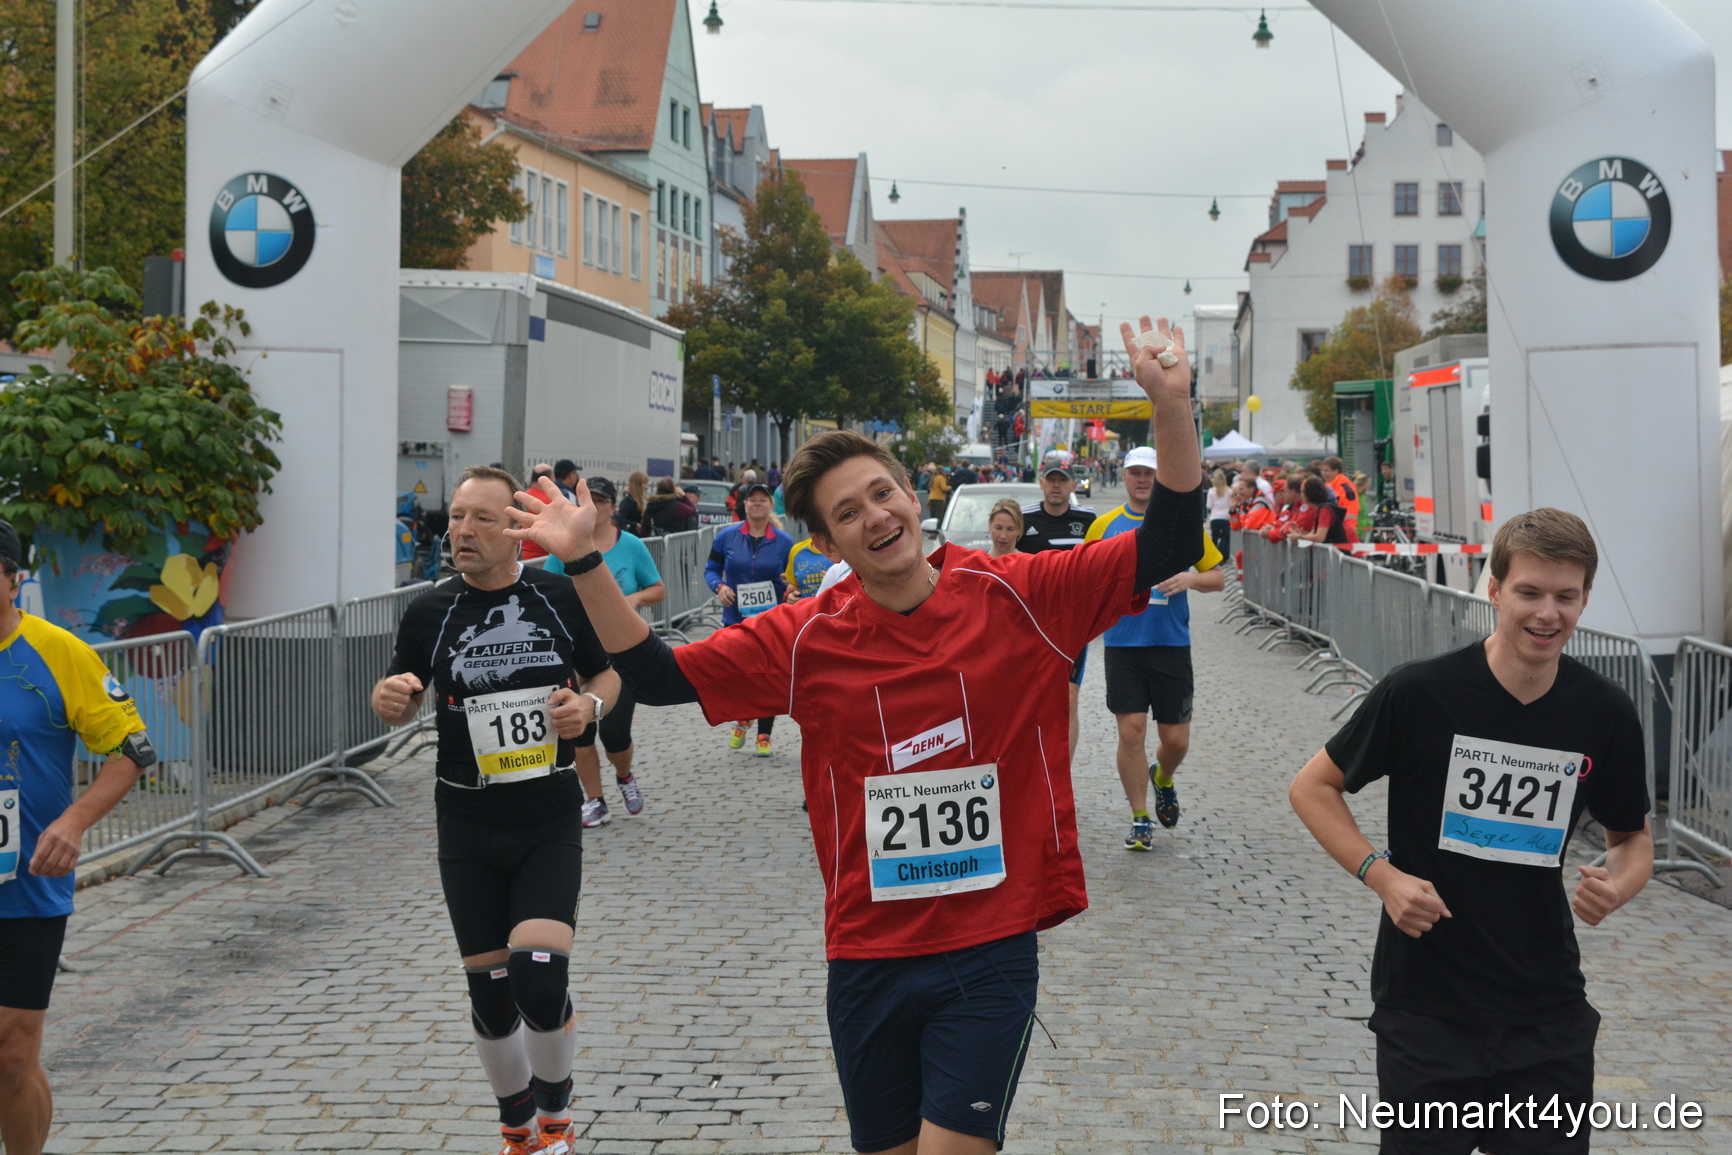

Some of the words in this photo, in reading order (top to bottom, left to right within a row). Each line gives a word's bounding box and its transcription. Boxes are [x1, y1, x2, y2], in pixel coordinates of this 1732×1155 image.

[1559, 159, 1662, 202] BMW
[216, 174, 307, 214] BMW
[1070, 404, 1112, 414] START
[742, 590, 773, 606] 2504
[472, 641, 533, 657] LAUFEN
[464, 658, 508, 669] GEGEN
[511, 654, 555, 665] LEIDEN
[468, 703, 500, 715] PARTL
[502, 697, 546, 709] Neumarkt
[489, 710, 547, 748] 183
[912, 733, 945, 756] DEHN
[499, 750, 547, 770] Michael
[1454, 747, 1498, 764] PARTL
[1501, 754, 1560, 773] Neumarkt
[868, 787, 911, 801] PARTL
[914, 780, 976, 797] Neumarkt
[1458, 767, 1562, 822] 3421
[881, 796, 990, 851] 2136
[874, 850, 880, 858] A
[897, 855, 979, 881] Christoph
